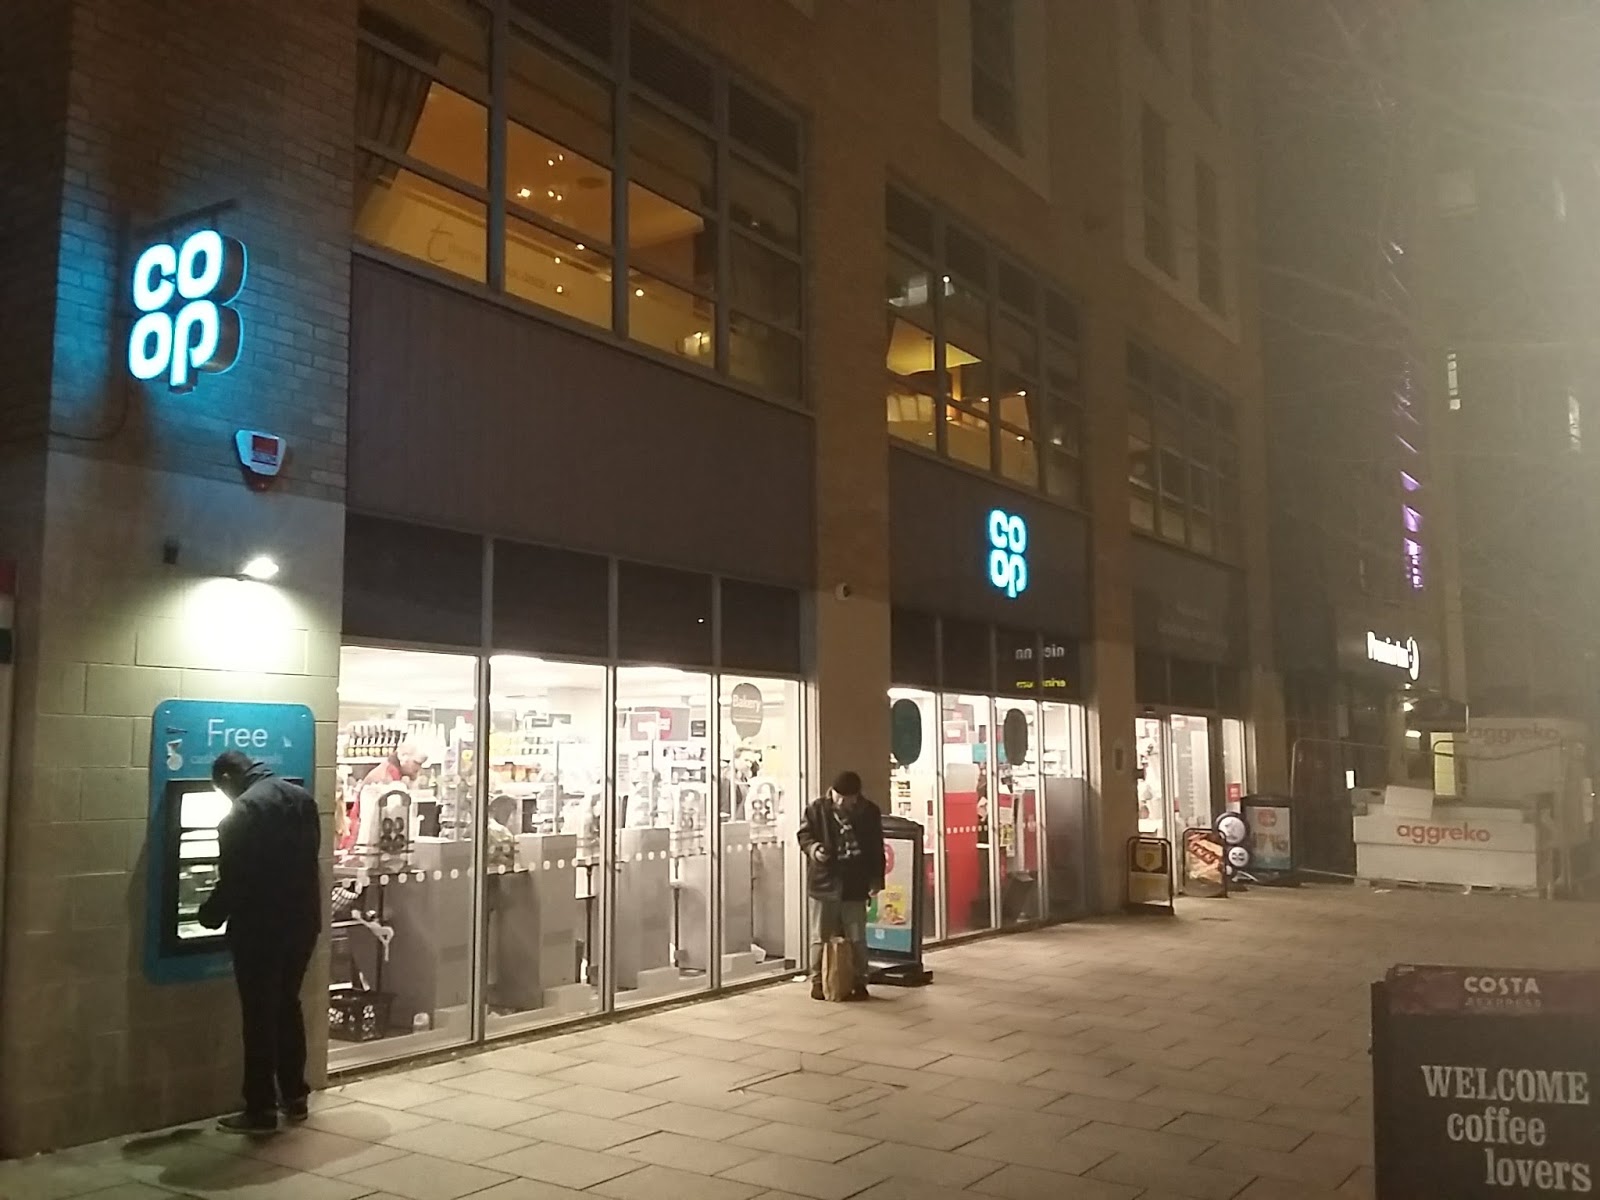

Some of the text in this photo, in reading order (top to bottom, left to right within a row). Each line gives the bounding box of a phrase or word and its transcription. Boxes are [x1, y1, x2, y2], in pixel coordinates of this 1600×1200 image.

[732, 694, 761, 713] Bakery
[207, 718, 269, 748] Free
[1396, 822, 1491, 844] aggreko
[1463, 976, 1541, 996] COSTA
[1420, 1064, 1590, 1105] WELCOME
[1447, 1106, 1546, 1147] coffee
[1484, 1148, 1592, 1193] lovers
